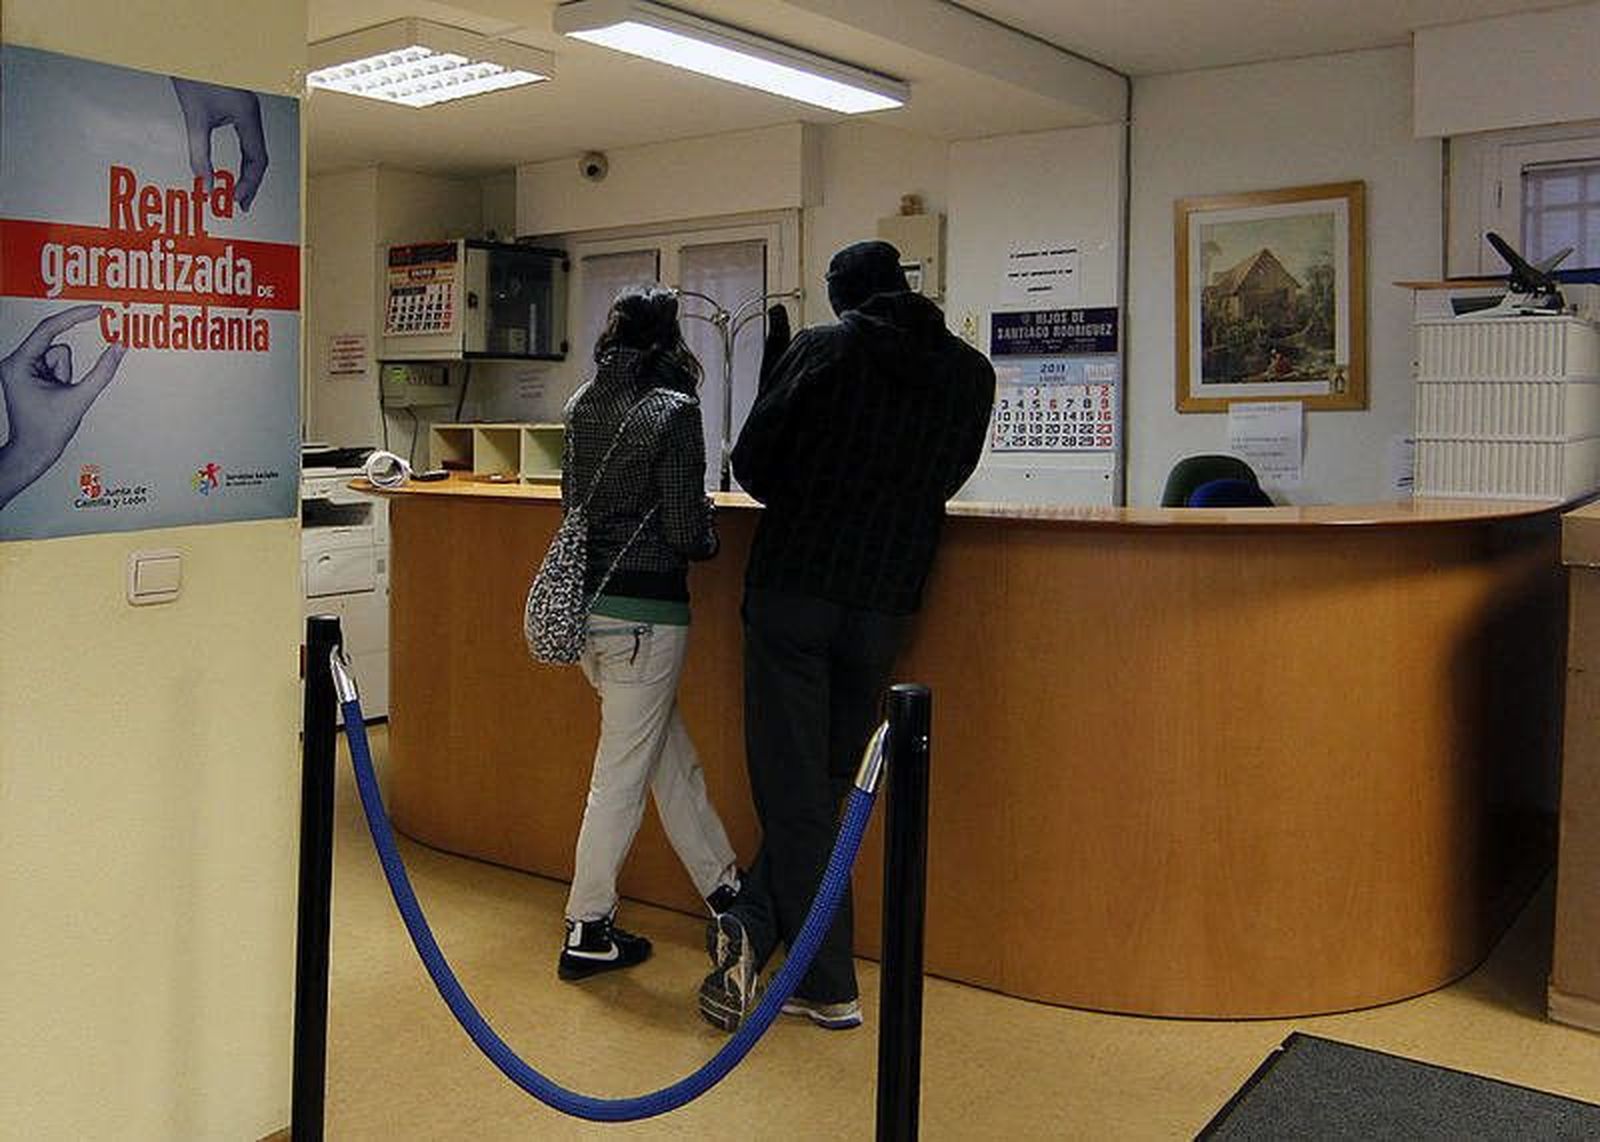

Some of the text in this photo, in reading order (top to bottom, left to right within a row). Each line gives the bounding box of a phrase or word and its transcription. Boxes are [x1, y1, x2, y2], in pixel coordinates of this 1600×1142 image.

[109, 164, 236, 238] Renta
[40, 239, 275, 299] garantizada DE
[1035, 311, 1085, 324] HIJOS DE
[100, 301, 271, 352] ciudadanía
[997, 323, 1113, 340] SANTIAGO RODRIGUEZ
[1040, 363, 1066, 373] 2011
[1100, 384, 1109, 396] 2
[1001, 399, 1009, 409] 3
[1016, 399, 1024, 409] 4
[1032, 399, 1040, 409] 5
[1066, 399, 1074, 409] 7
[1100, 399, 1109, 409] 9
[997, 411, 1112, 421] 10 11 12 13 14 15 16
[997, 423, 1113, 433] 17 18 19 20 21 22 23
[1012, 436, 1026, 446] 25
[1028, 436, 1043, 446] 26
[1045, 436, 1059, 446] 27
[1061, 436, 1077, 446] 28
[1078, 436, 1095, 446] 29
[1096, 436, 1113, 446] 30
